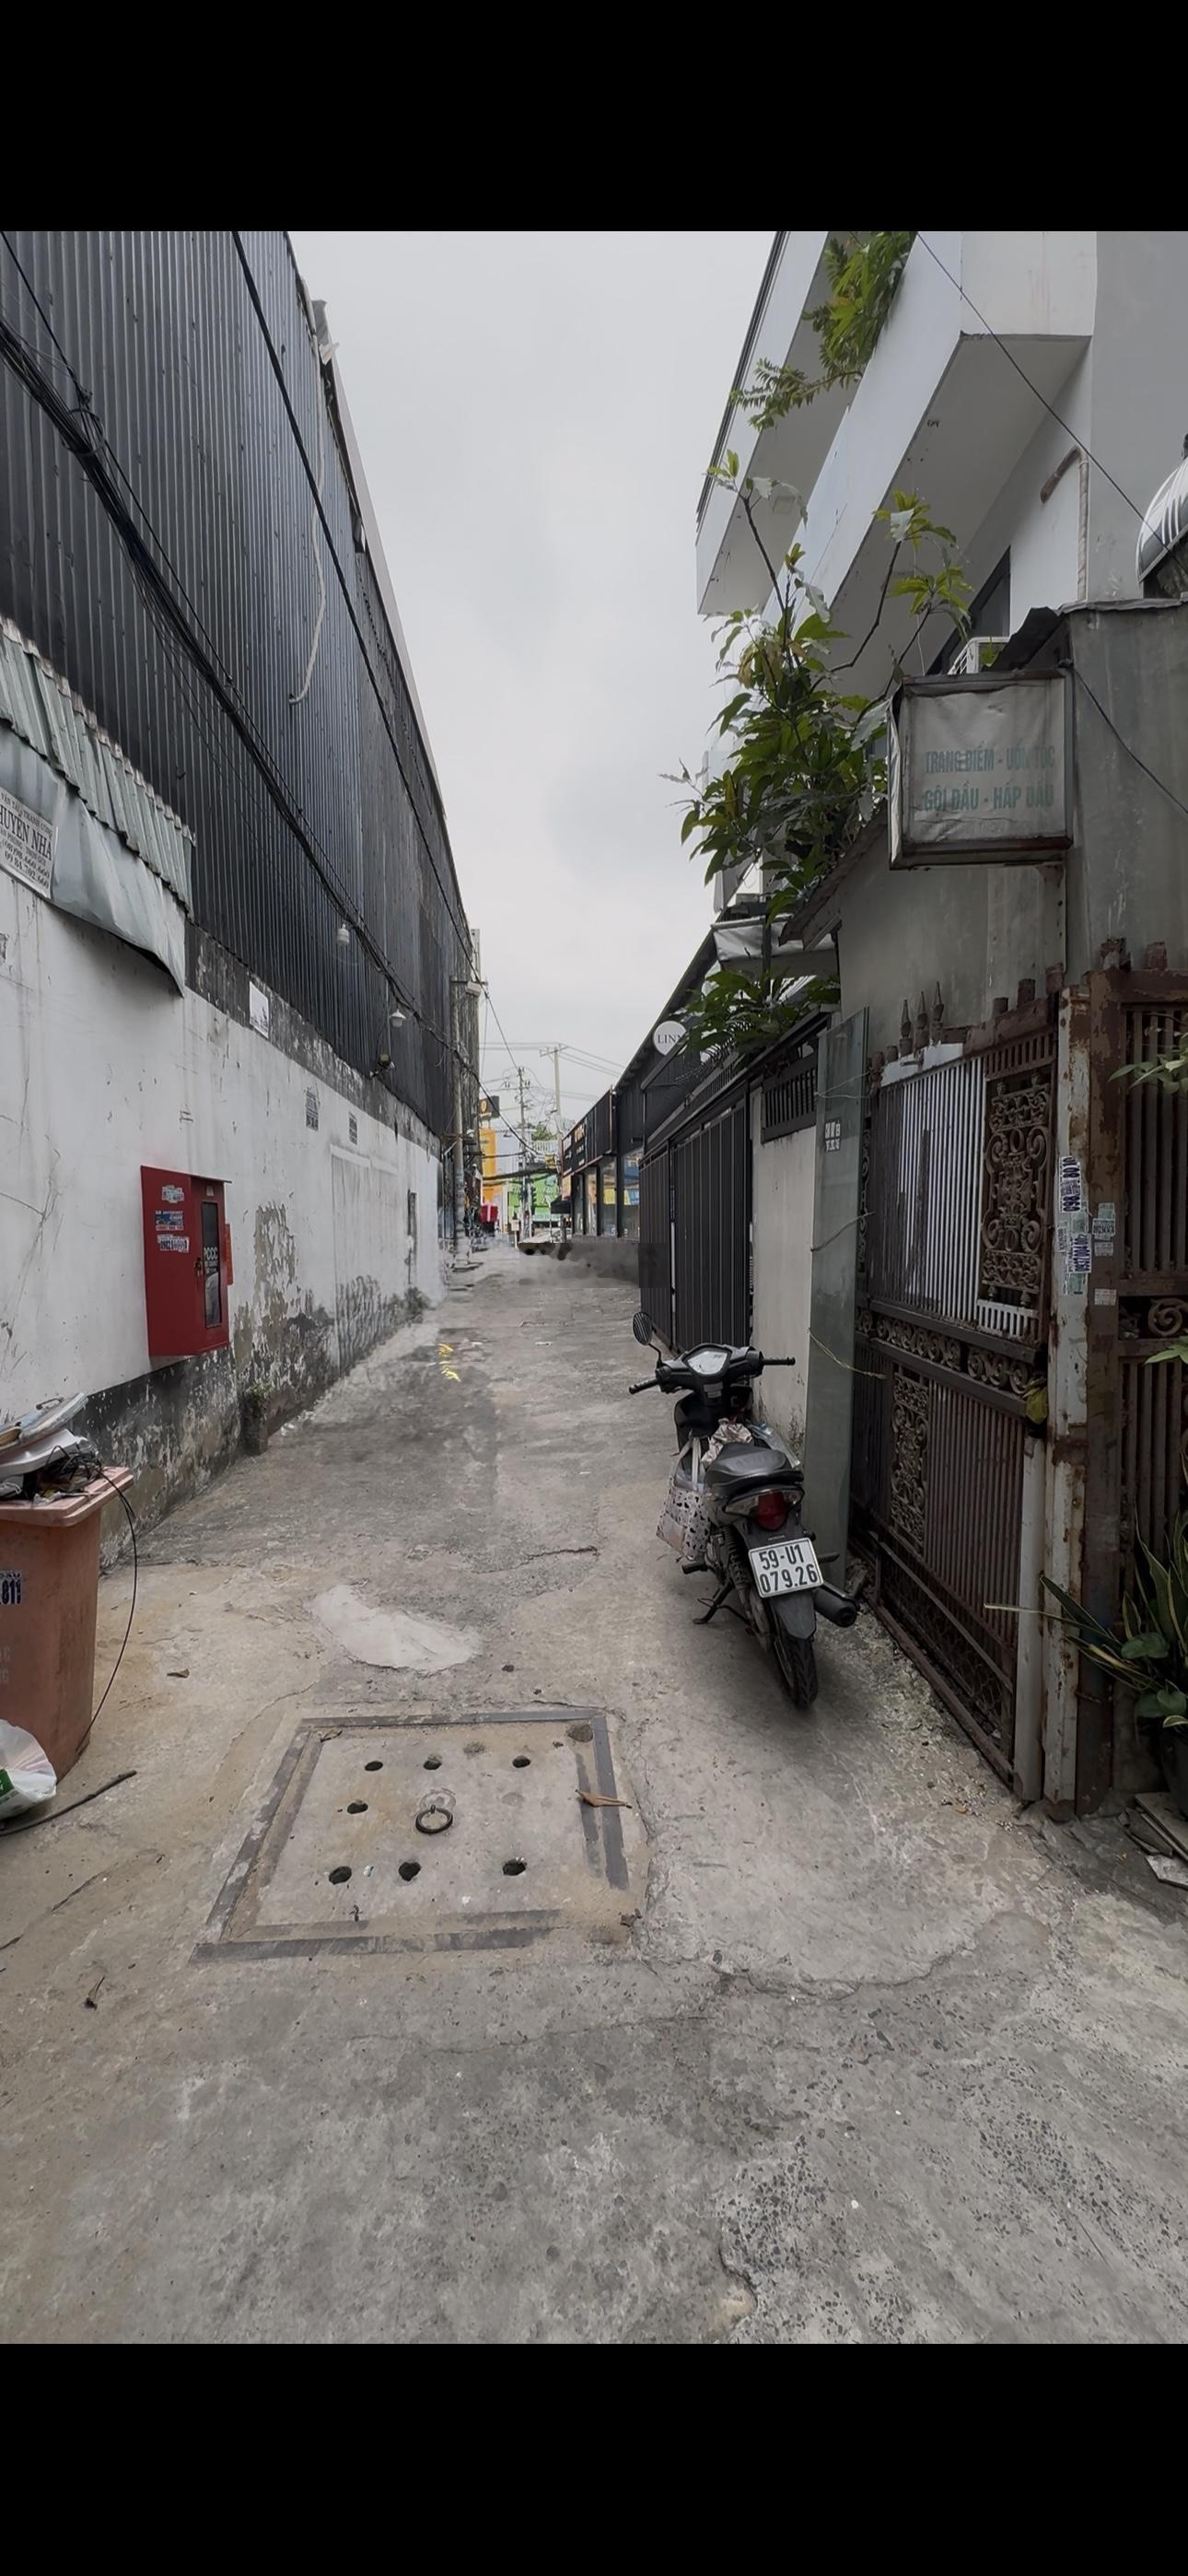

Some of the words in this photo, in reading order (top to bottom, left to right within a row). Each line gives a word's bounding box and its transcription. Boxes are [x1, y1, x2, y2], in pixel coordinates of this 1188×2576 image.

[926, 749, 963, 774] TRANG
[758, 1544, 804, 1570] 59-U1
[759, 1563, 818, 1593] 079.26
